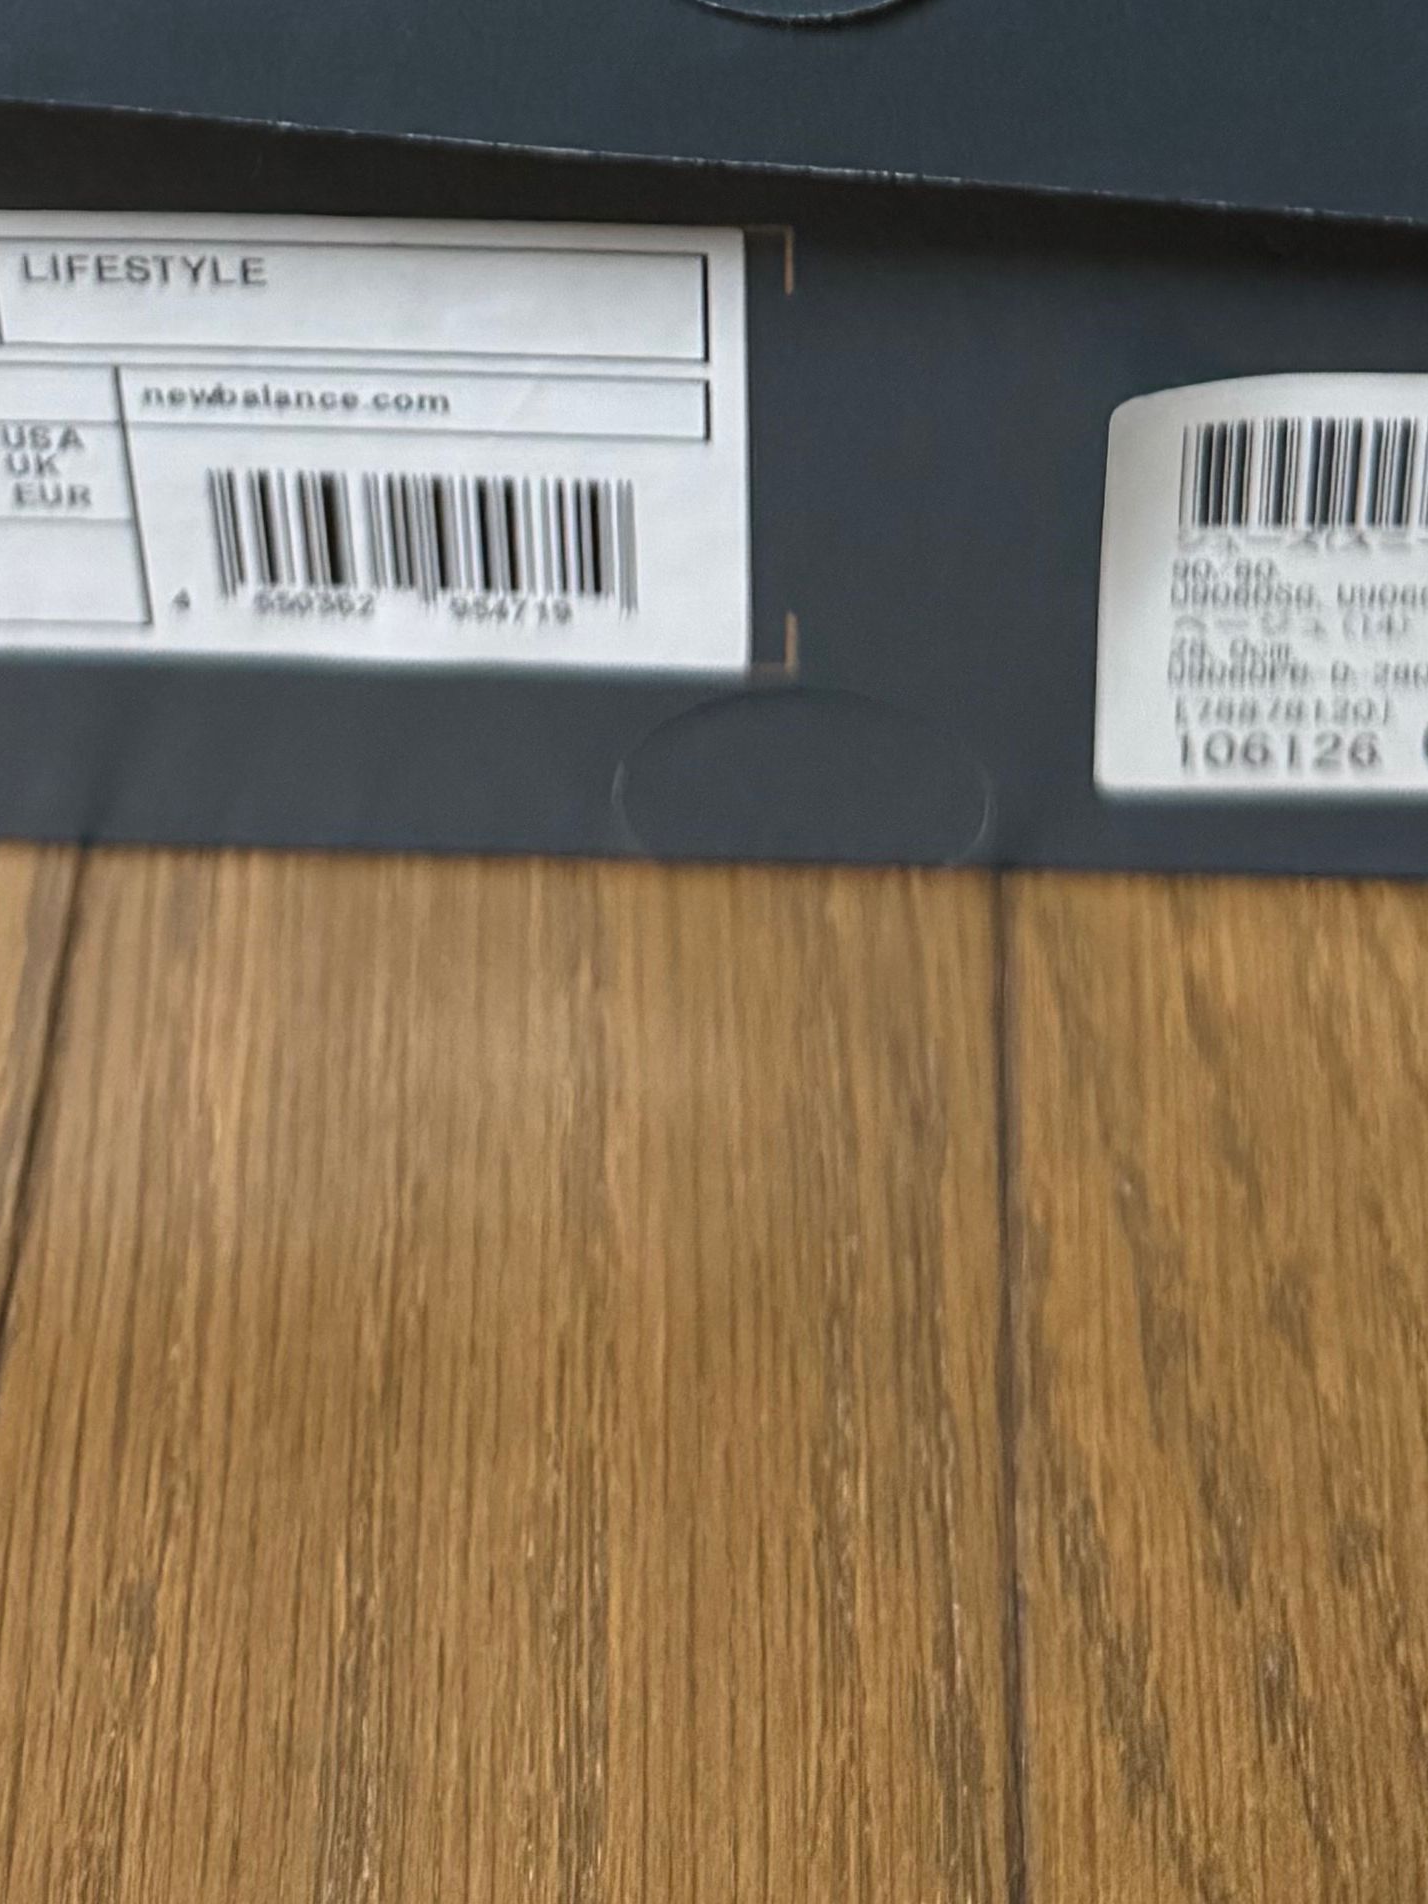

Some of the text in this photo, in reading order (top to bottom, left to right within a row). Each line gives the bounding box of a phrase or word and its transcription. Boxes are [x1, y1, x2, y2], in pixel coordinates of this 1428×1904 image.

[22, 253, 267, 288] LIFESTYLE
[142, 384, 450, 414] newbalance.com
[1, 424, 84, 450] USA
[5, 451, 59, 477] UK
[13, 481, 92, 509] EUR
[1179, 730, 1378, 769] 106126
